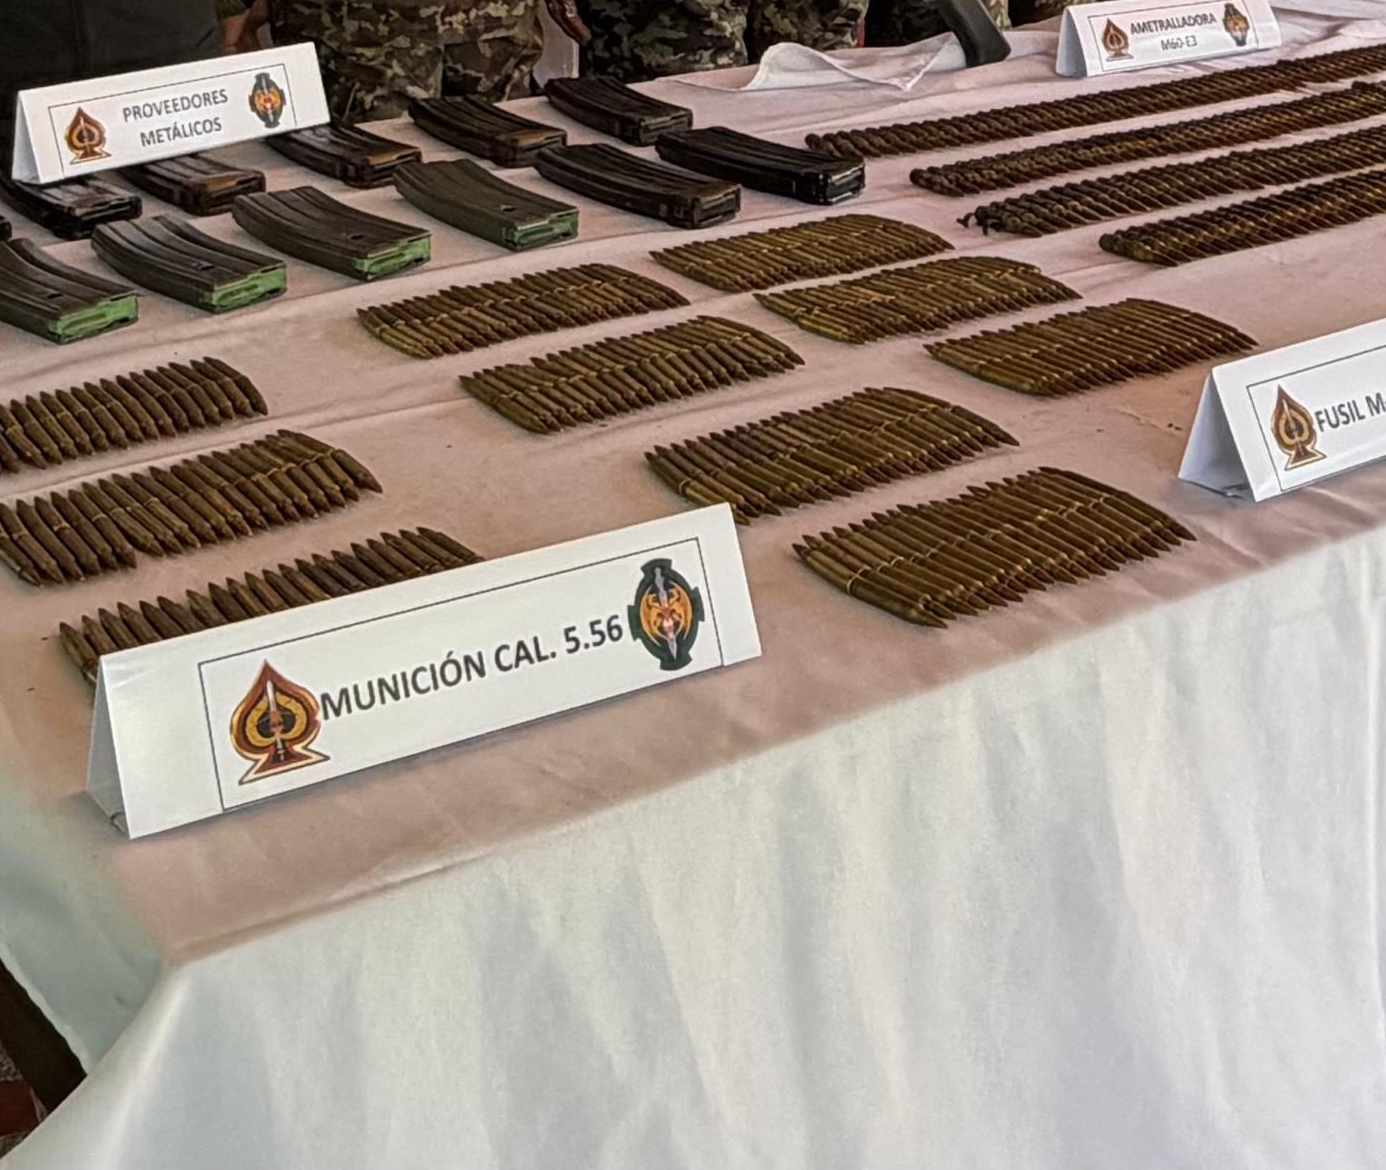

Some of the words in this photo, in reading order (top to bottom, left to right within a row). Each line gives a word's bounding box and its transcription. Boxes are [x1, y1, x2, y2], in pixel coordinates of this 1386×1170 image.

[1130, 13, 1217, 36] AMETRALLADORA
[122, 88, 229, 122] PROVEEDORES
[140, 117, 222, 147] METÁLICOS
[1315, 398, 1365, 432] FUSIL
[319, 648, 486, 721] MUNICIÓN
[493, 635, 558, 672] CAL.
[565, 614, 625, 656] 5.56
